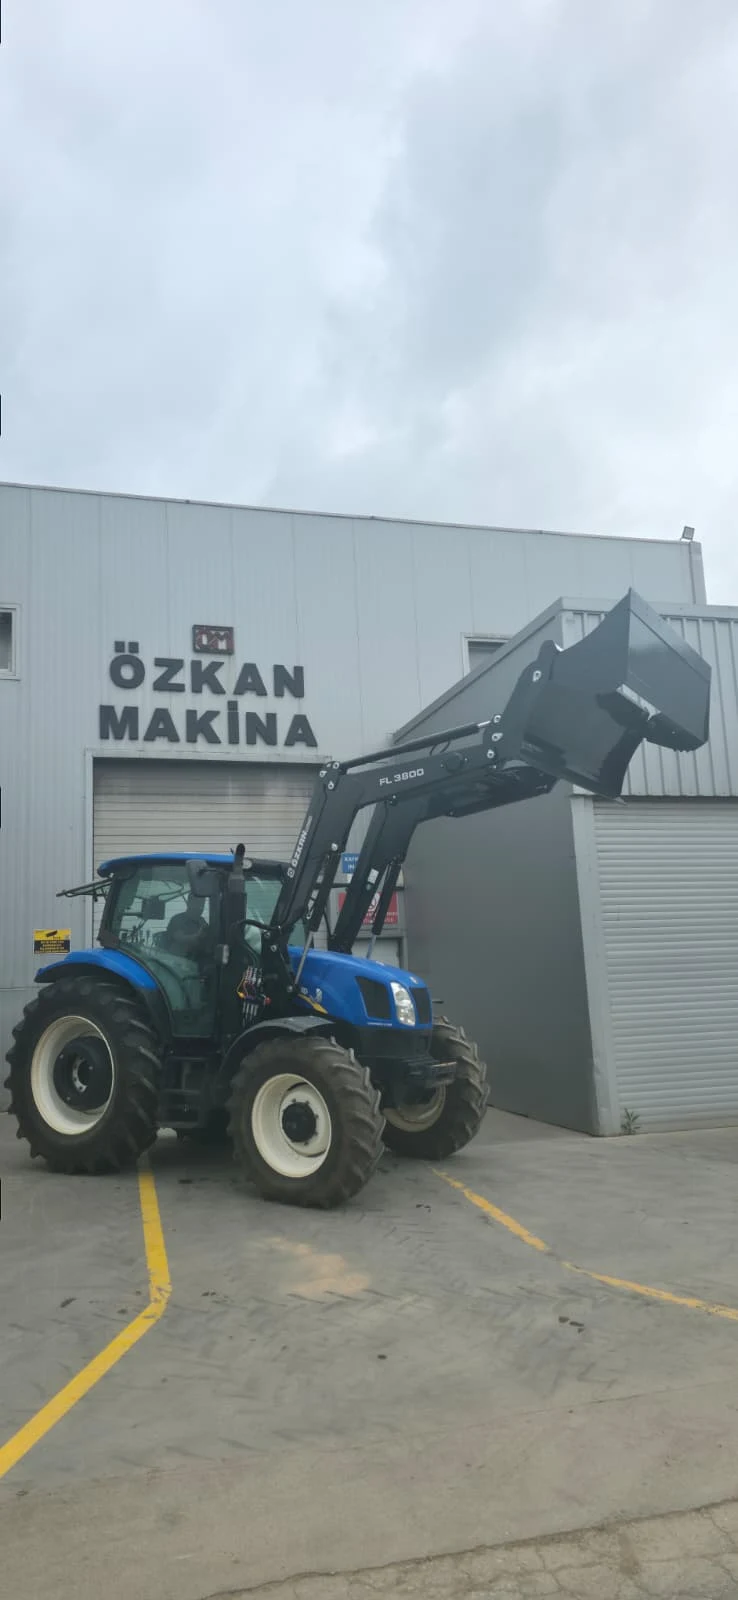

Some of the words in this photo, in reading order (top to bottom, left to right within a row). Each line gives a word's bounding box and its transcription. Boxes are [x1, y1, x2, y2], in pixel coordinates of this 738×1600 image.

[109, 640, 305, 698] ÖZKAN
[99, 700, 318, 747] MAKİNA
[379, 777, 393, 787] FL
